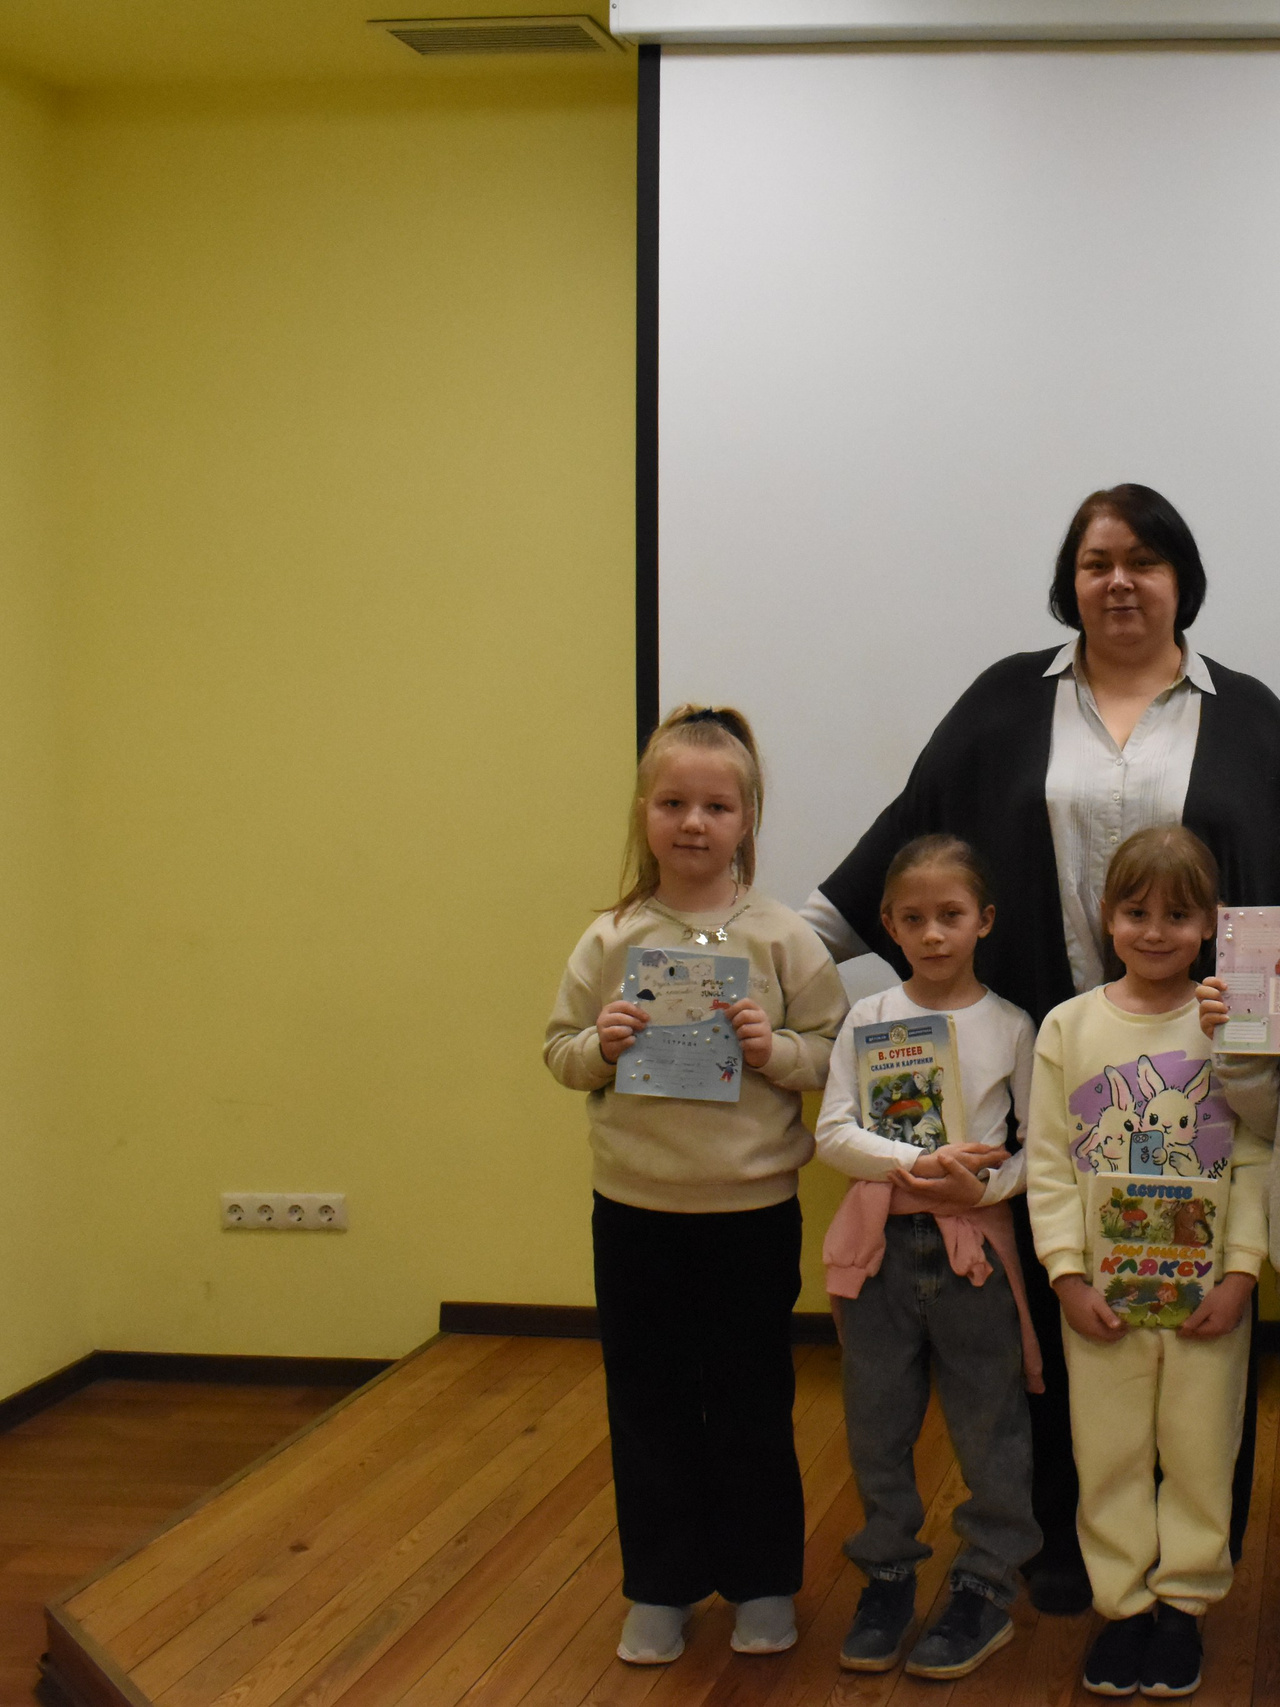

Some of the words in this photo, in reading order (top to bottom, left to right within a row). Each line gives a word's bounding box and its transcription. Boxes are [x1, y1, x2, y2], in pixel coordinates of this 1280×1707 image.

[878, 1051, 887, 1061] В.
[889, 1045, 923, 1059] СУТЕЕВ
[871, 1062, 894, 1072] СКАЗКИ
[902, 1056, 934, 1067] КАРТИНКИ
[1111, 1244, 1144, 1257] МЫ
[1146, 1246, 1206, 1259] ИЩЕМ
[1100, 1256, 1213, 1278] КЛЯКСУ
